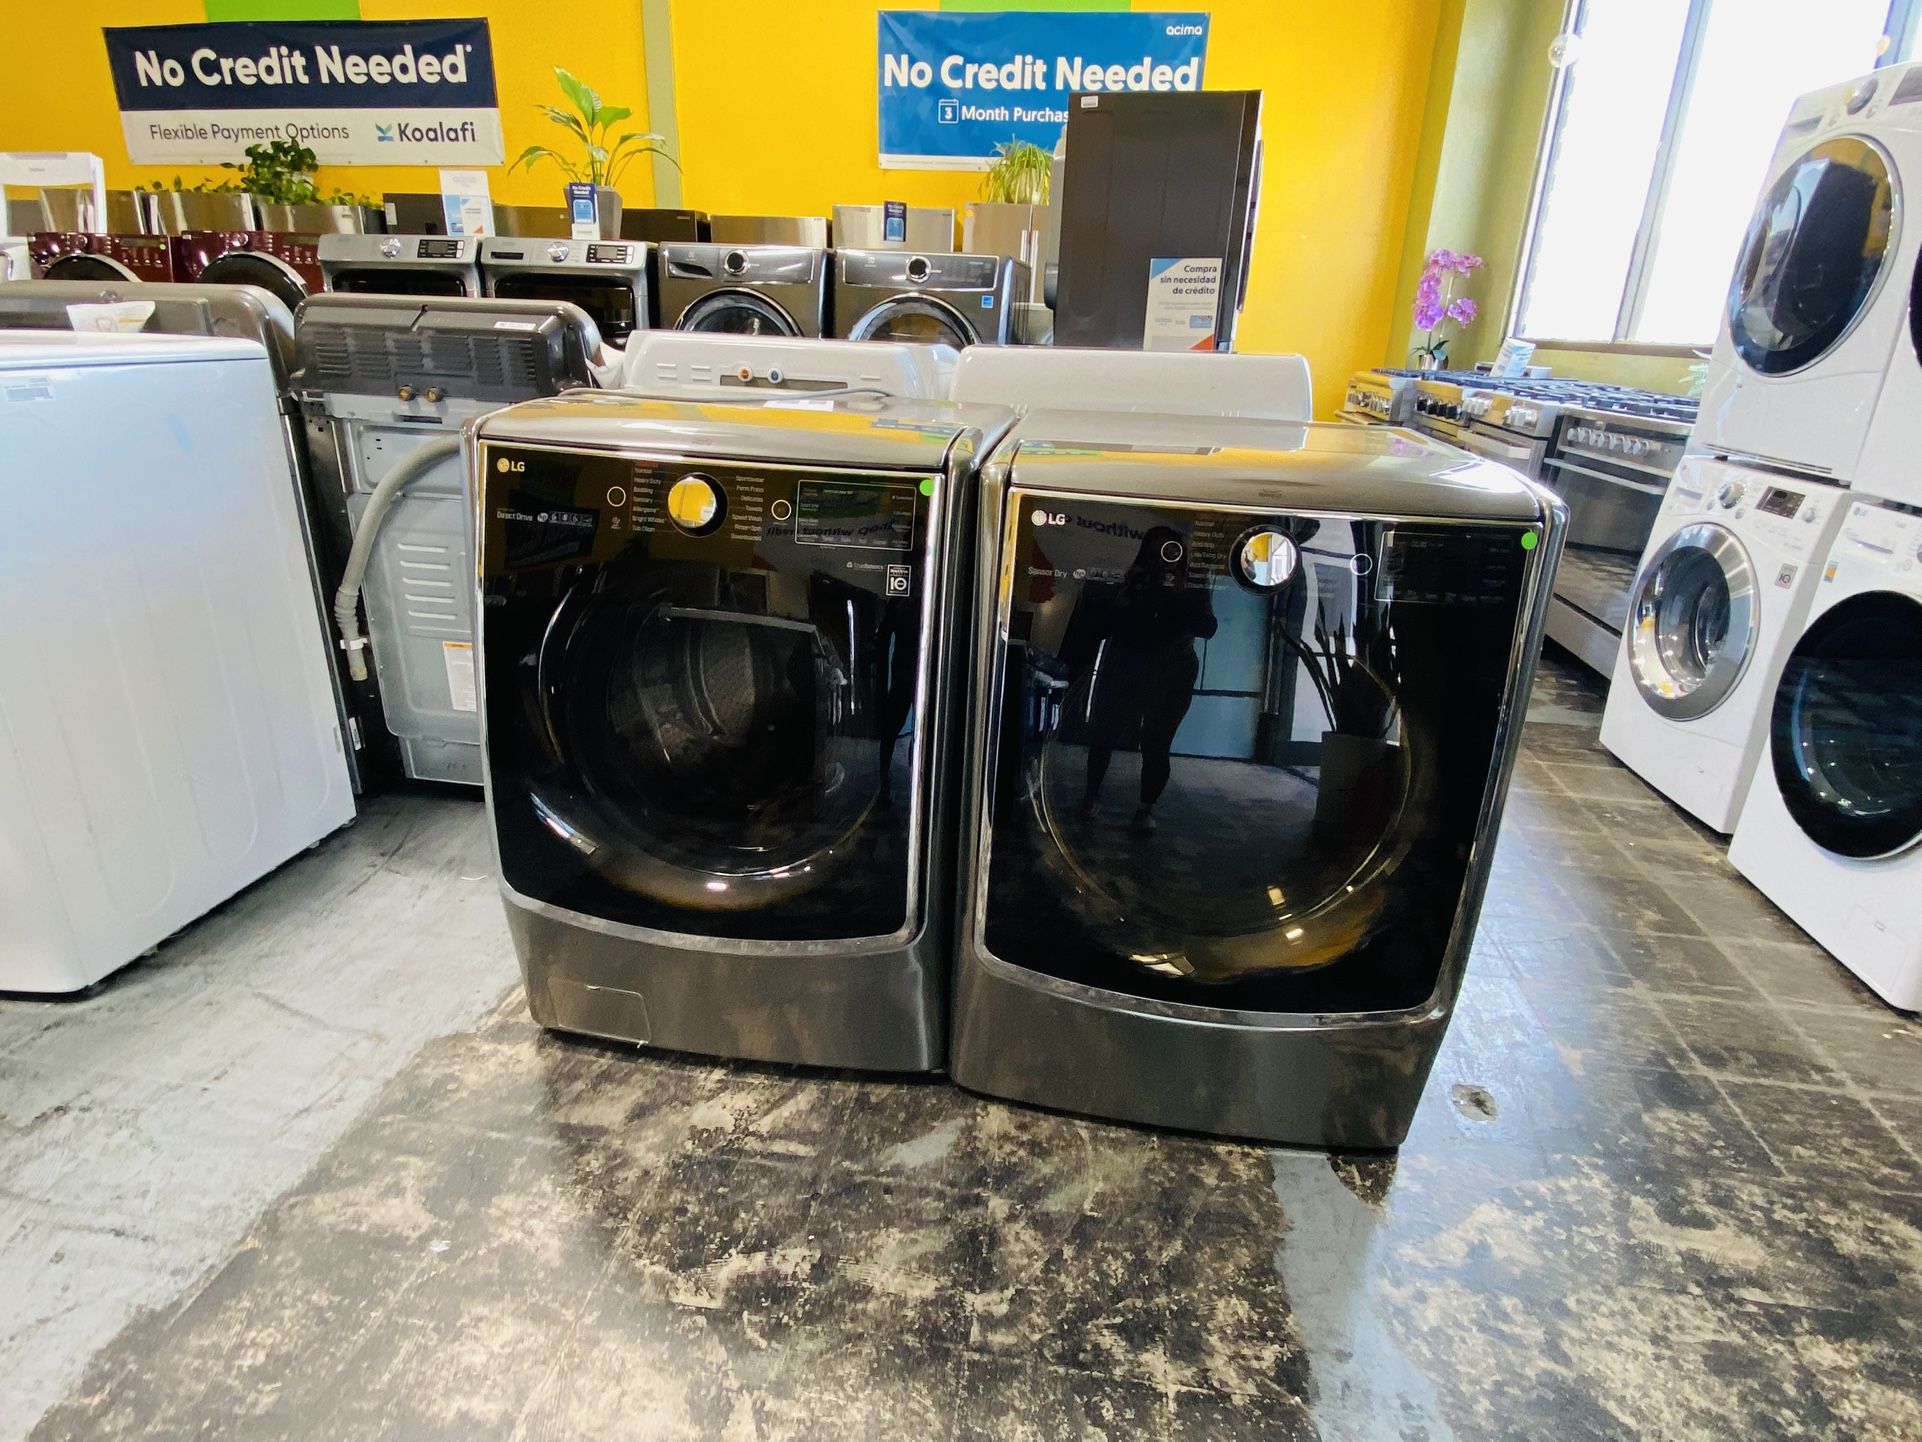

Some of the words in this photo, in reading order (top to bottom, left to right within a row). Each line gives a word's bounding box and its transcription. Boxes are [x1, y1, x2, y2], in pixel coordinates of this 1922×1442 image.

[1166, 24, 1203, 36] acima
[134, 50, 185, 87] No
[191, 46, 310, 86] Credit
[884, 54, 933, 88] No
[940, 55, 1047, 90] Credit
[1055, 56, 1200, 91] Needed
[961, 105, 1009, 121] Month
[1013, 107, 1069, 122] Purchas
[150, 124, 208, 140] Flexible
[211, 123, 282, 143] Payment
[285, 123, 350, 143] Options
[397, 121, 477, 142] Koalafi
[1183, 265, 1217, 274] Compra
[1160, 276, 1172, 284] sin
[1173, 275, 1216, 284] necesidad
[1185, 286, 1215, 295] crédito
[510, 461, 525, 473] LG
[496, 510, 516, 520] Direct
[516, 512, 533, 521] Drive
[1048, 513, 1066, 525] LG
[1028, 566, 1053, 577] Sensor
[1054, 569, 1068, 578] Dry
